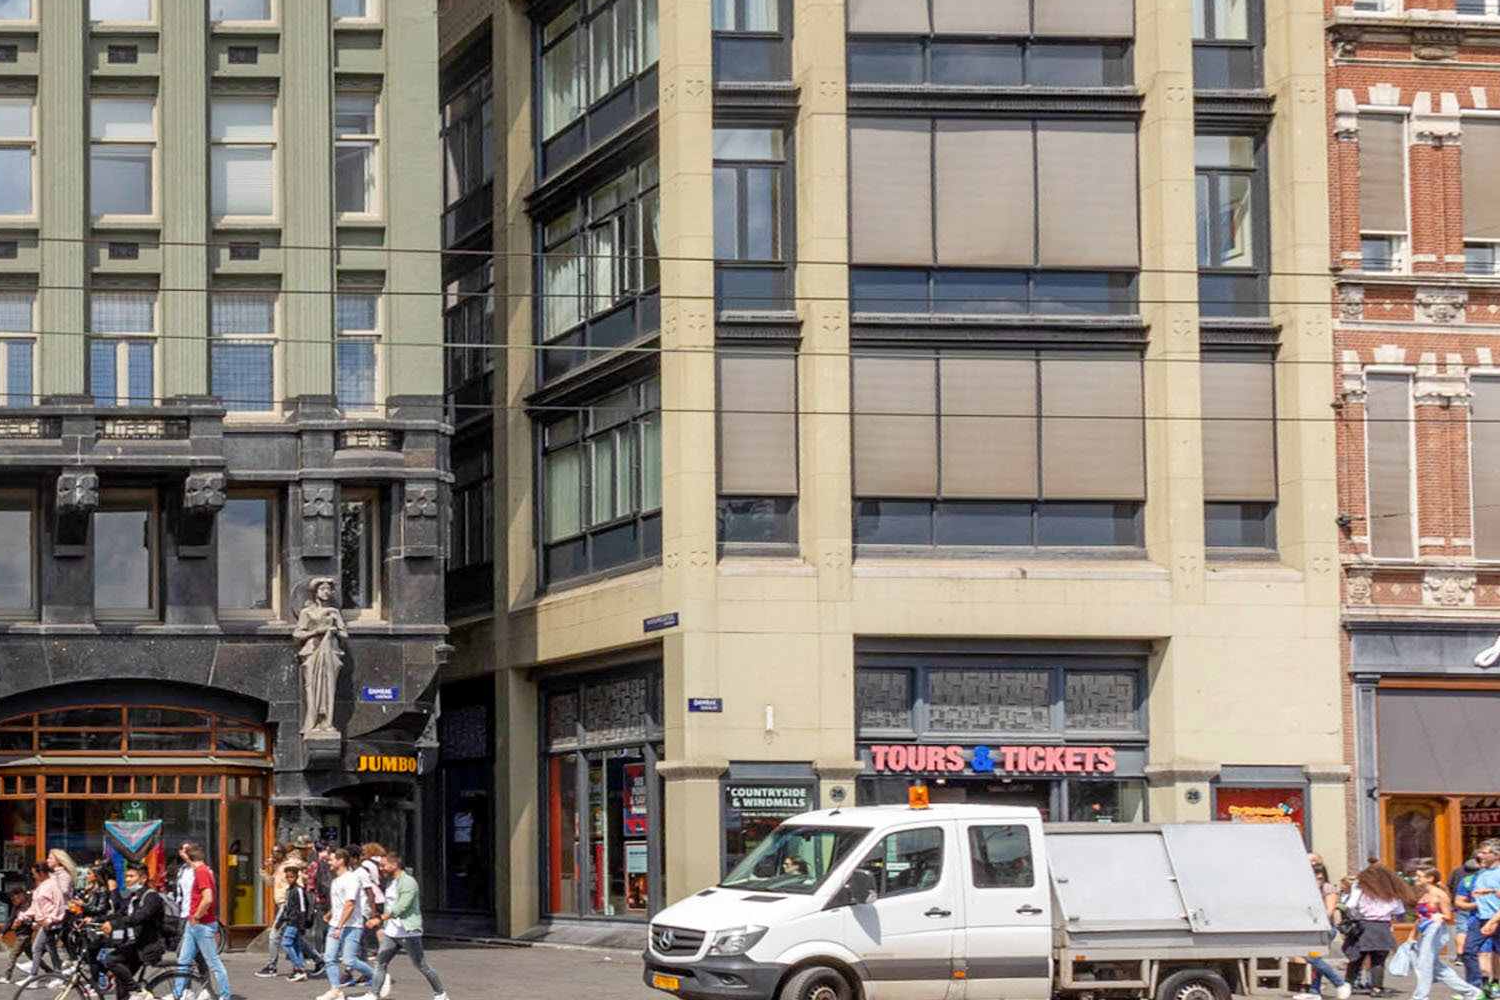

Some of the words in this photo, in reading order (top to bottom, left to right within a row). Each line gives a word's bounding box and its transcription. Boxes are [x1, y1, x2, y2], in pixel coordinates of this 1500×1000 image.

[357, 755, 417, 772] JUMBO
[870, 745, 965, 772] TOURS
[970, 745, 994, 772] &
[1000, 746, 1117, 773] TICKETS
[731, 788, 806, 797] COUNTRYSIDE
[743, 798, 805, 807] WINDMILLS
